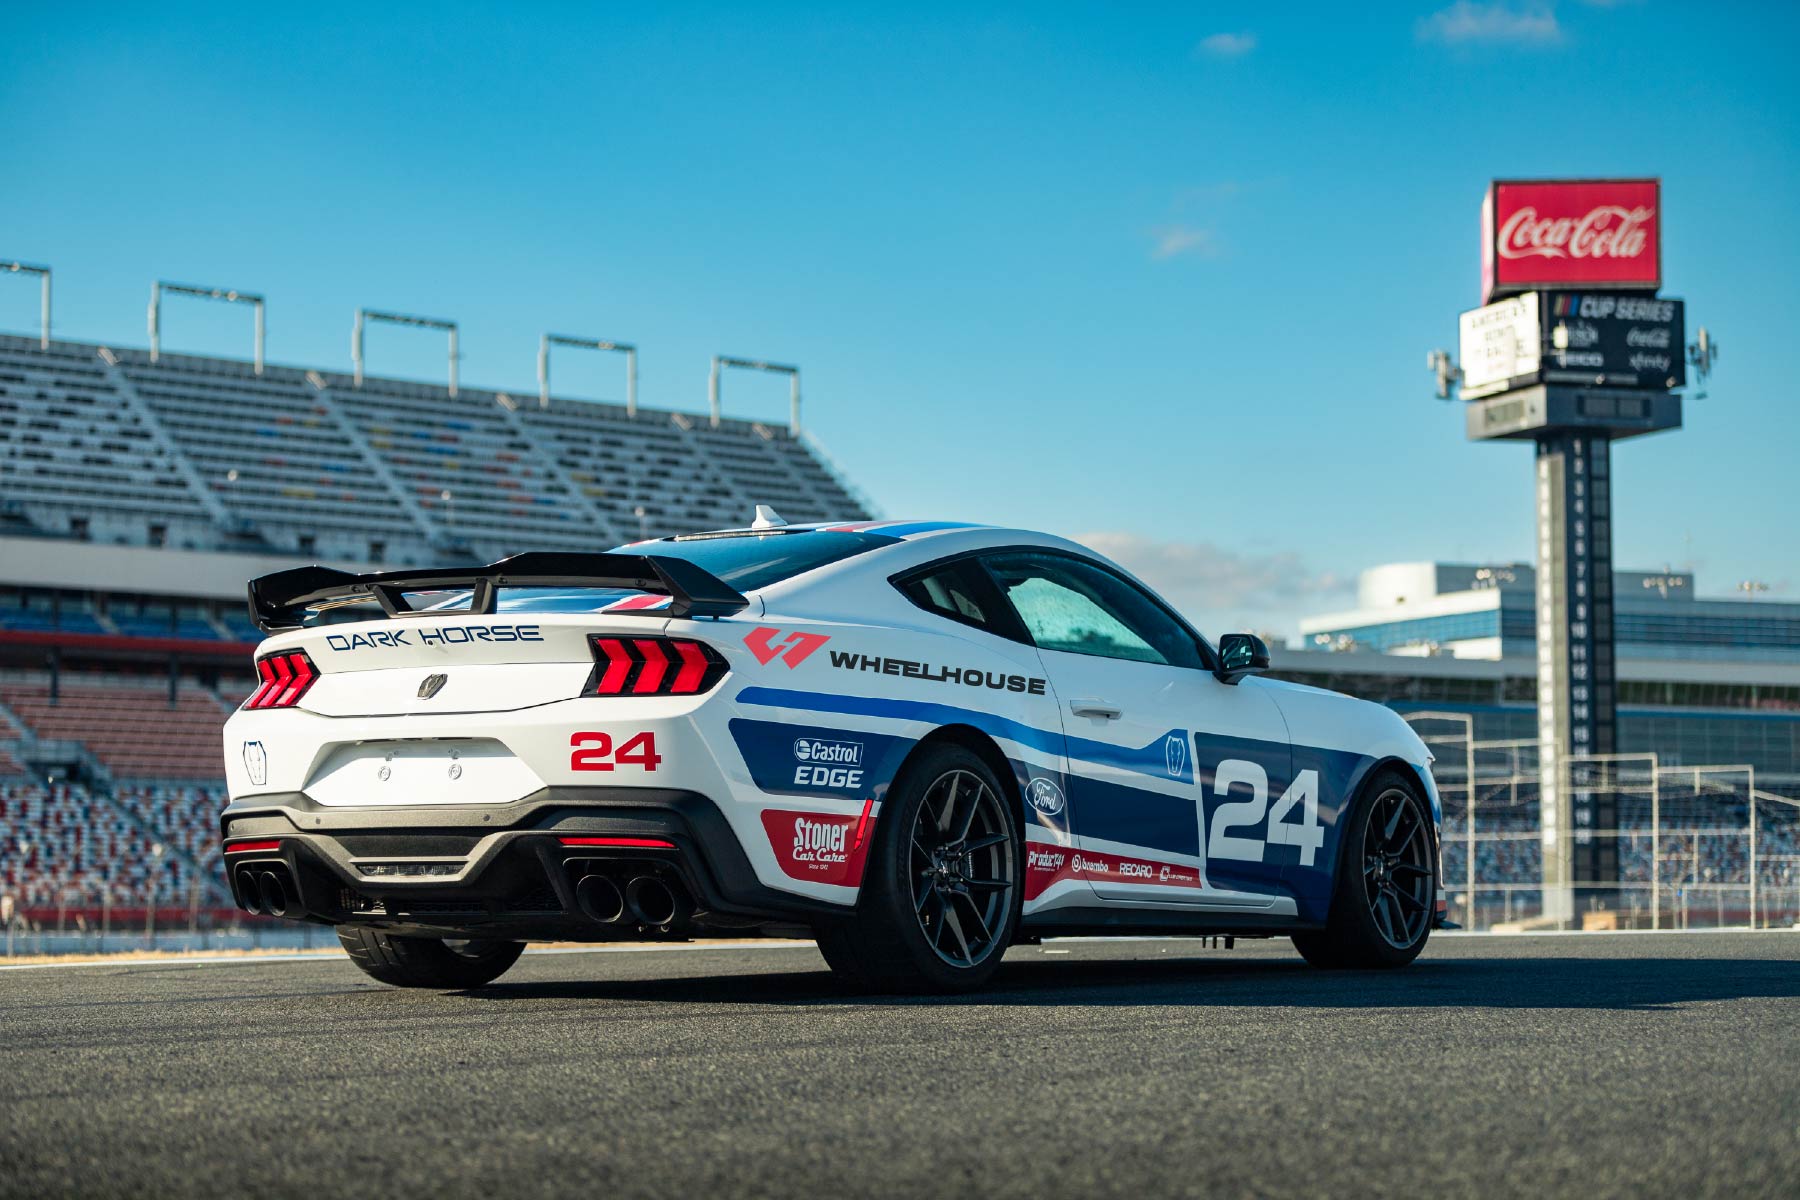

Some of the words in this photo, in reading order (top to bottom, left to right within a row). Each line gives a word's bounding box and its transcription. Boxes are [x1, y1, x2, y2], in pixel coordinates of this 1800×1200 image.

[1498, 205, 1655, 260] Coca-Cola
[1580, 295, 1616, 319] CUP
[1615, 297, 1675, 323] SERIES
[326, 629, 412, 651] DARK
[418, 625, 544, 645] HORSE
[830, 650, 1046, 695] WHEELHOUSE
[570, 731, 662, 771] 24
[811, 742, 858, 763] Castrol
[794, 766, 864, 788] EDGE
[1034, 781, 1057, 810] Ford
[1207, 758, 1325, 867] 24
[793, 817, 849, 852] Stoner
[792, 846, 815, 861] Car
[1081, 857, 1109, 873] brembo
[1119, 862, 1153, 878] RECARO
